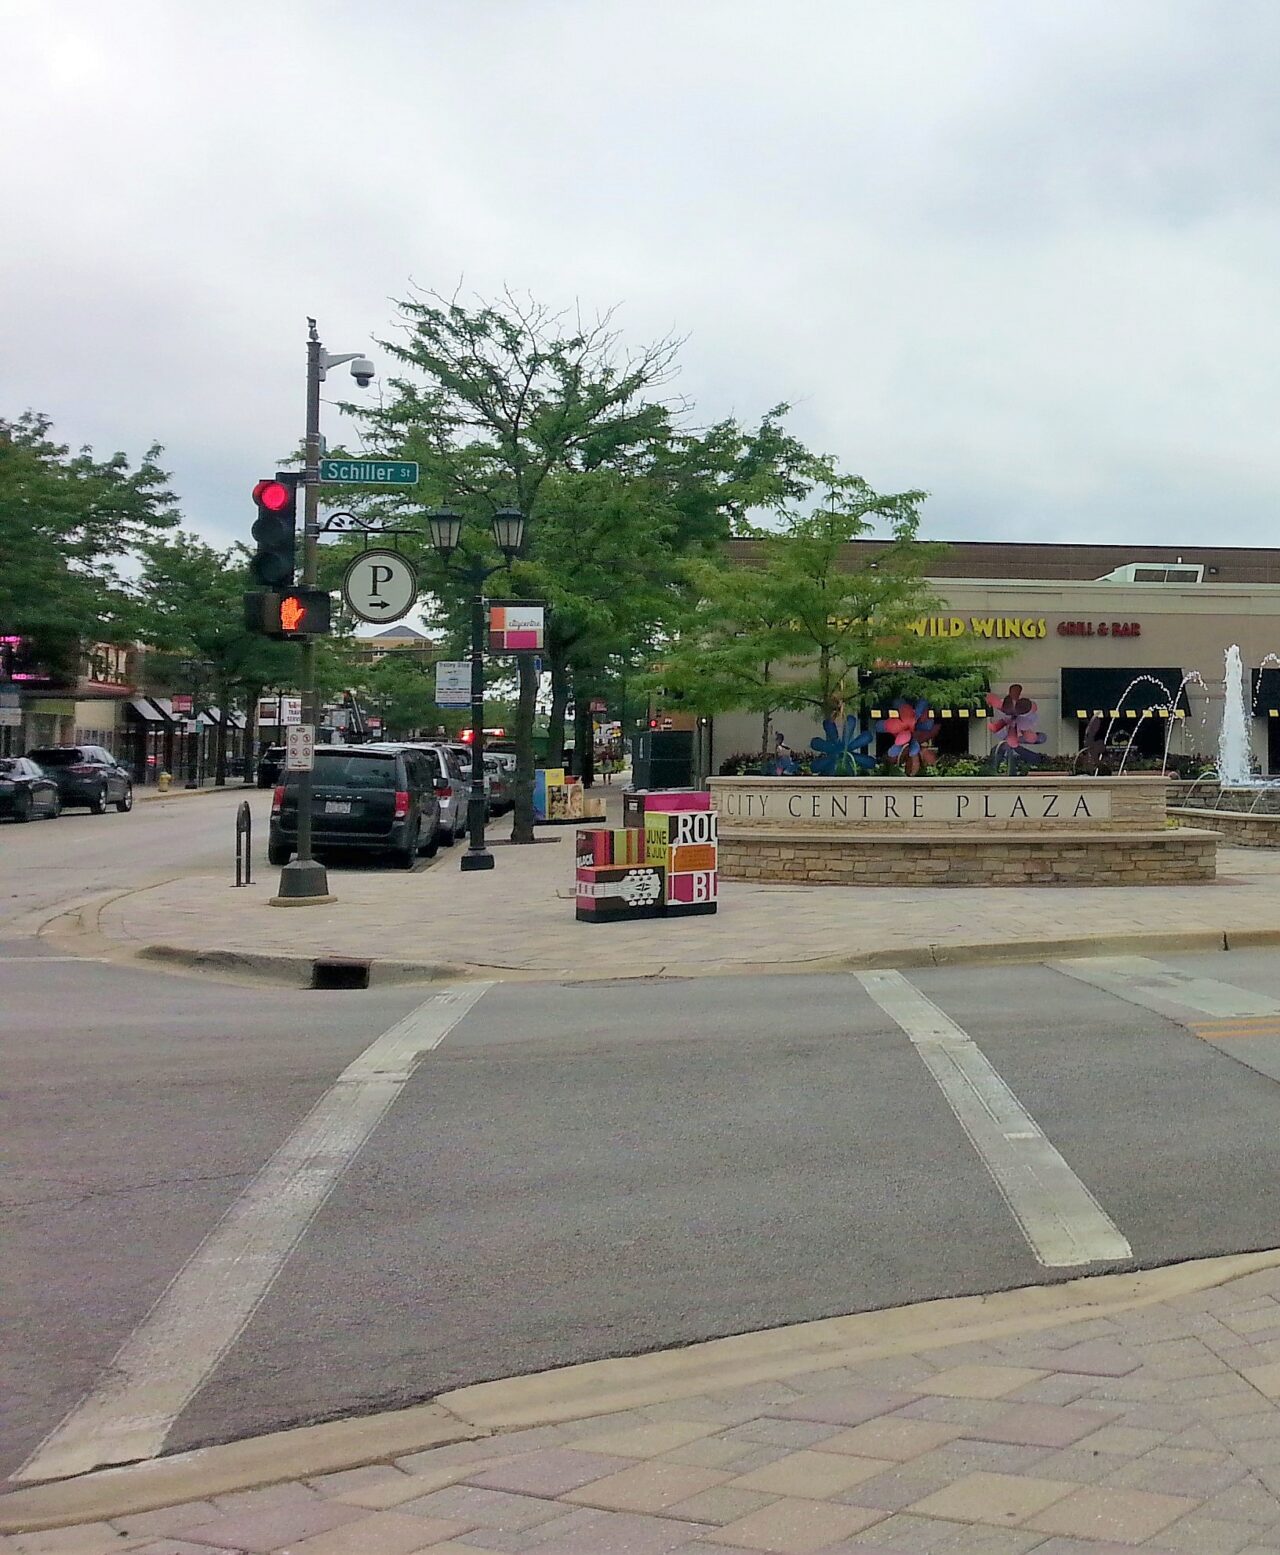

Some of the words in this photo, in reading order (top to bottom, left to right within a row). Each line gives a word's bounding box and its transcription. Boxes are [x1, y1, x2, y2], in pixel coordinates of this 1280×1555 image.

[328, 462, 394, 480] Schiller
[400, 468, 410, 478] St
[367, 565, 393, 596] P
[907, 617, 966, 638] WILD
[970, 617, 1047, 639] WINGS
[1057, 621, 1095, 636] GRILL
[1097, 622, 1109, 636] &
[1111, 622, 1141, 637] BAR
[727, 793, 769, 817] CITY
[788, 794, 924, 818] CENTRE
[956, 794, 1092, 818] PLAZA
[646, 829, 667, 845] JUNE
[652, 847, 667, 859] JULY
